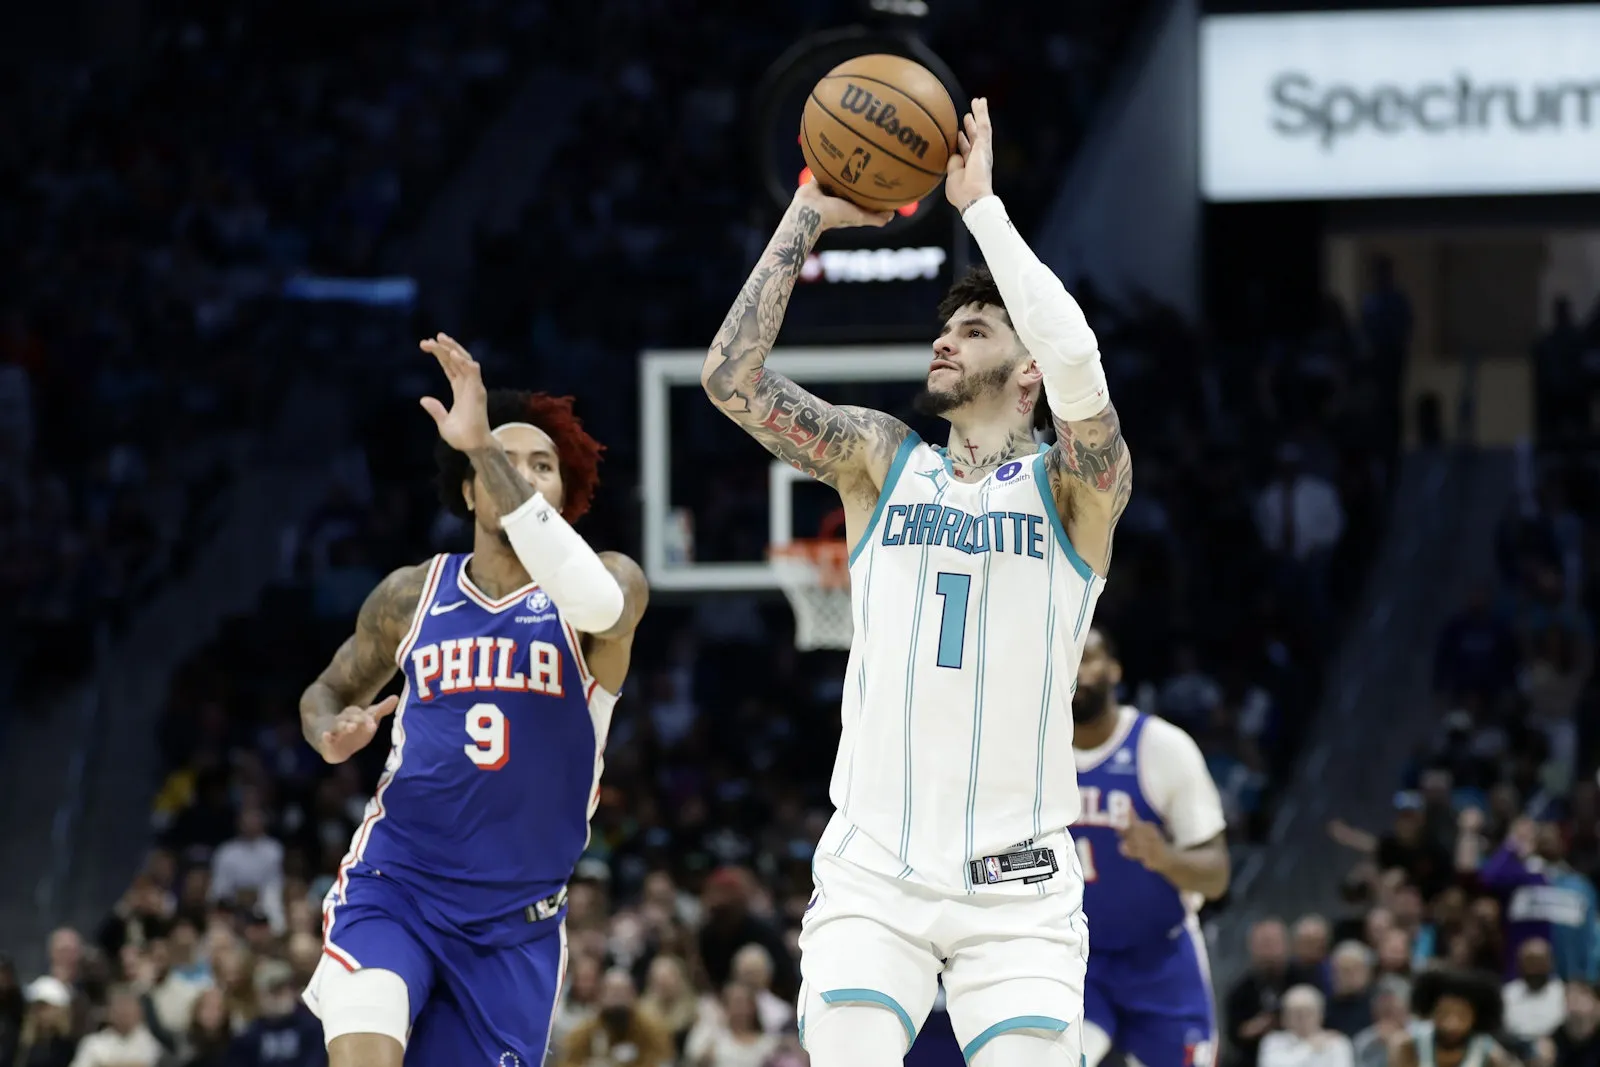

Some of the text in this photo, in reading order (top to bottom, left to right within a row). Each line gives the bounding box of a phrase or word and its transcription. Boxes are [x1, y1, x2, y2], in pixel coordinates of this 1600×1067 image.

[840, 82, 930, 159] Wilson
[1268, 68, 1600, 153] Spectrum
[882, 503, 1043, 560] CHARLOTTE
[936, 572, 971, 669] 1
[411, 636, 565, 701] PHILA
[464, 703, 510, 771] 9
